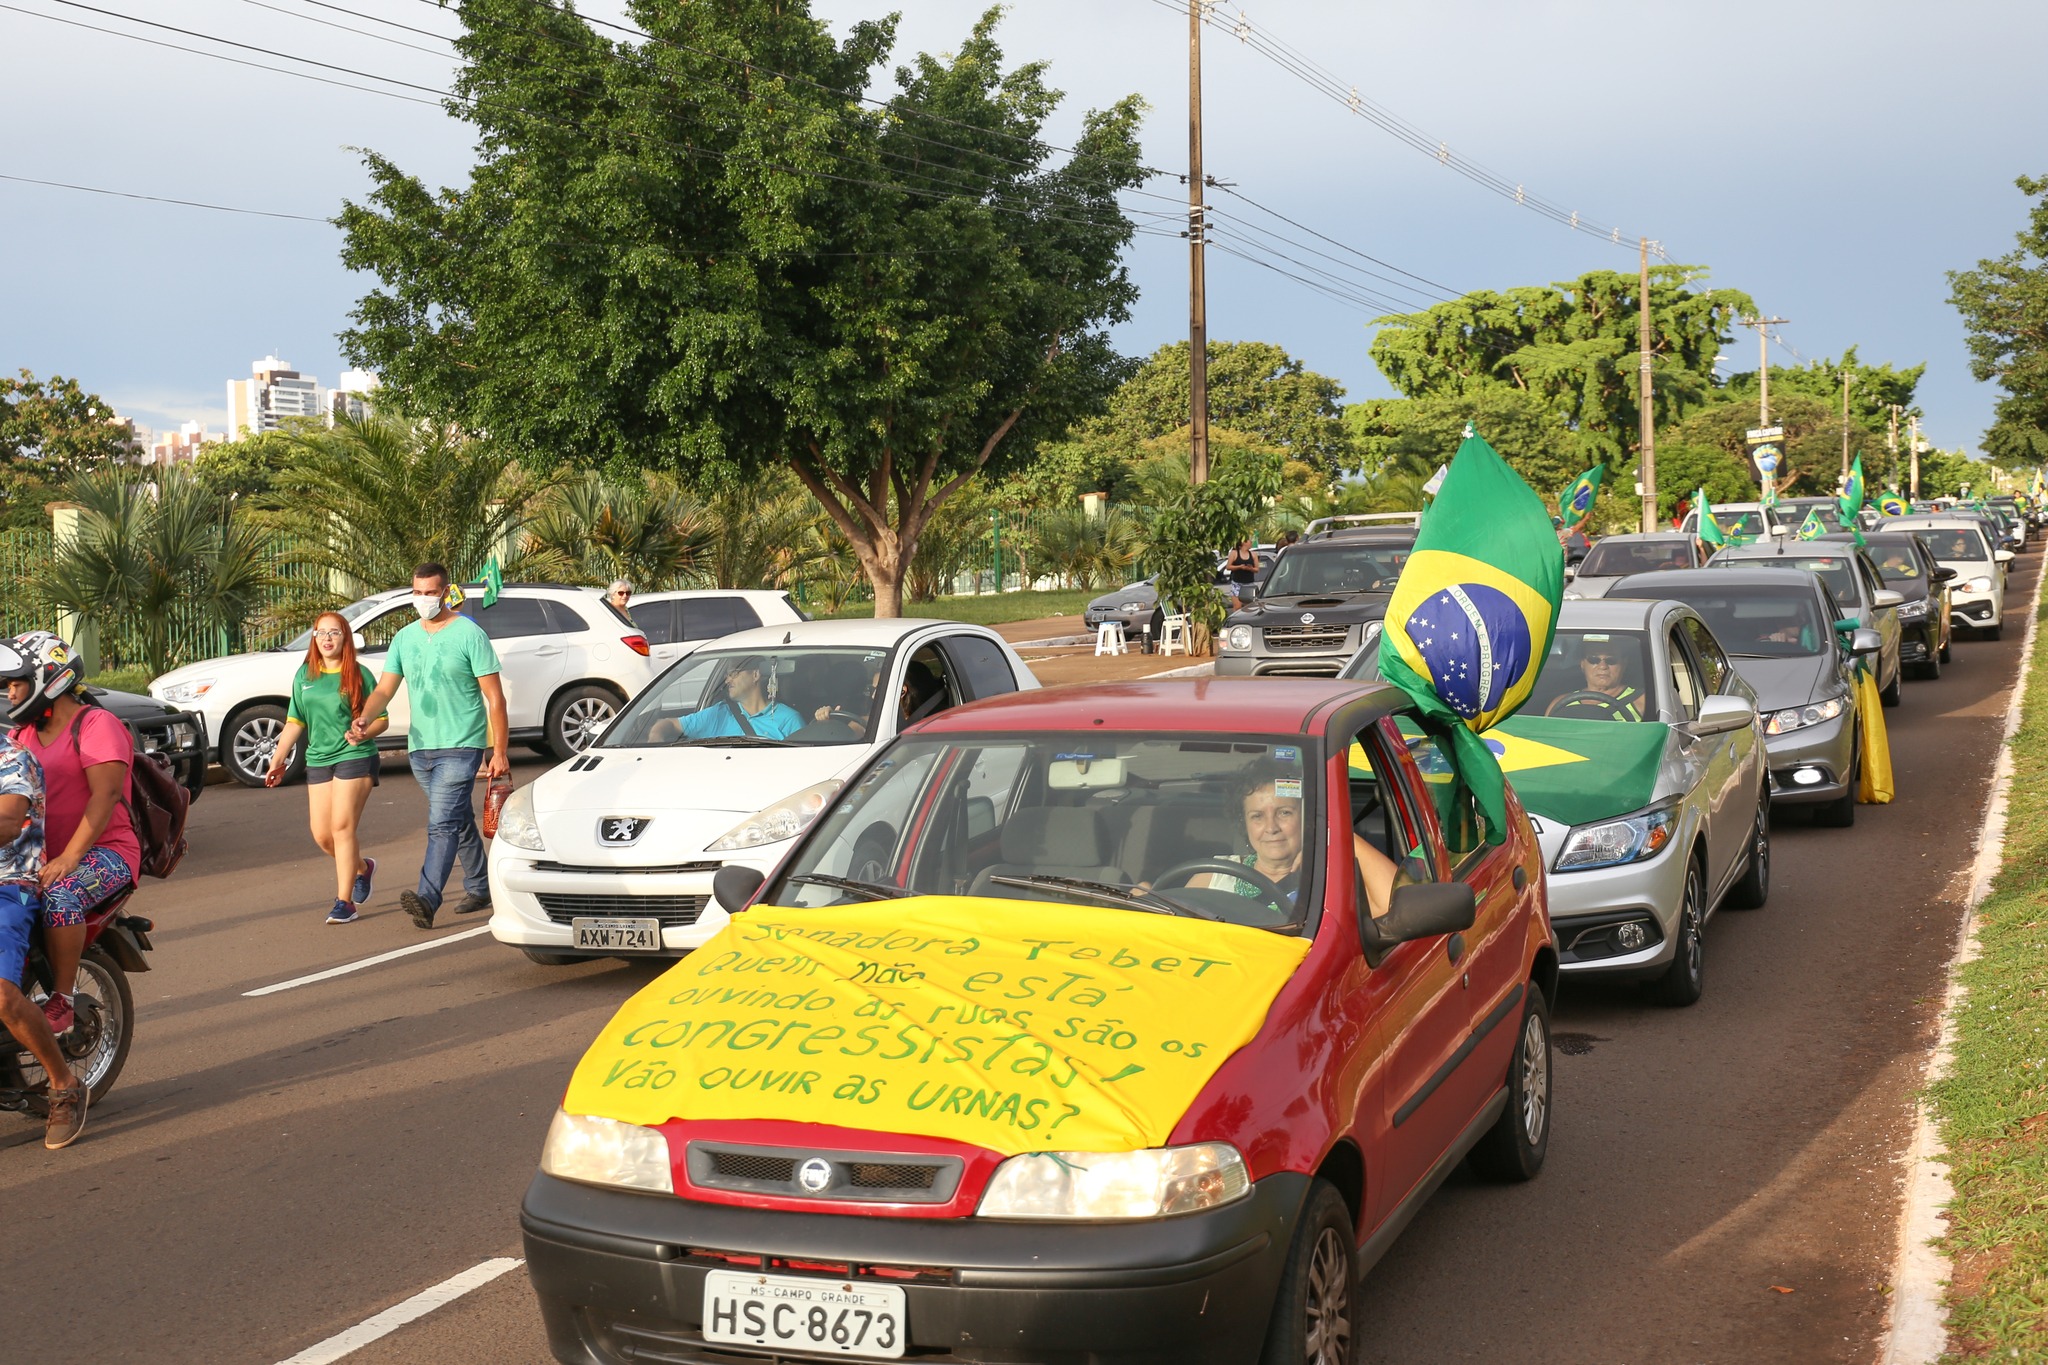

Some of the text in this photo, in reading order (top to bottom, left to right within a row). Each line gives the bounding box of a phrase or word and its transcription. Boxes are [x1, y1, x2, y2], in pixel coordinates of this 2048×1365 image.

[1453, 589, 1482, 629] ORDEM
[1479, 644, 1491, 704] PROGRESS
[698, 951, 825, 977] Quem
[834, 961, 926, 985] não
[668, 985, 836, 1011] ouvindo
[927, 1003, 1033, 1029] ruas
[1053, 1017, 1137, 1050] são
[1160, 1040, 1208, 1059] os
[699, 1067, 822, 1095] OUVIR
[833, 1074, 887, 1105] as
[907, 1080, 1081, 1140] URNAS?
[821, 1291, 866, 1305] GRANDE
